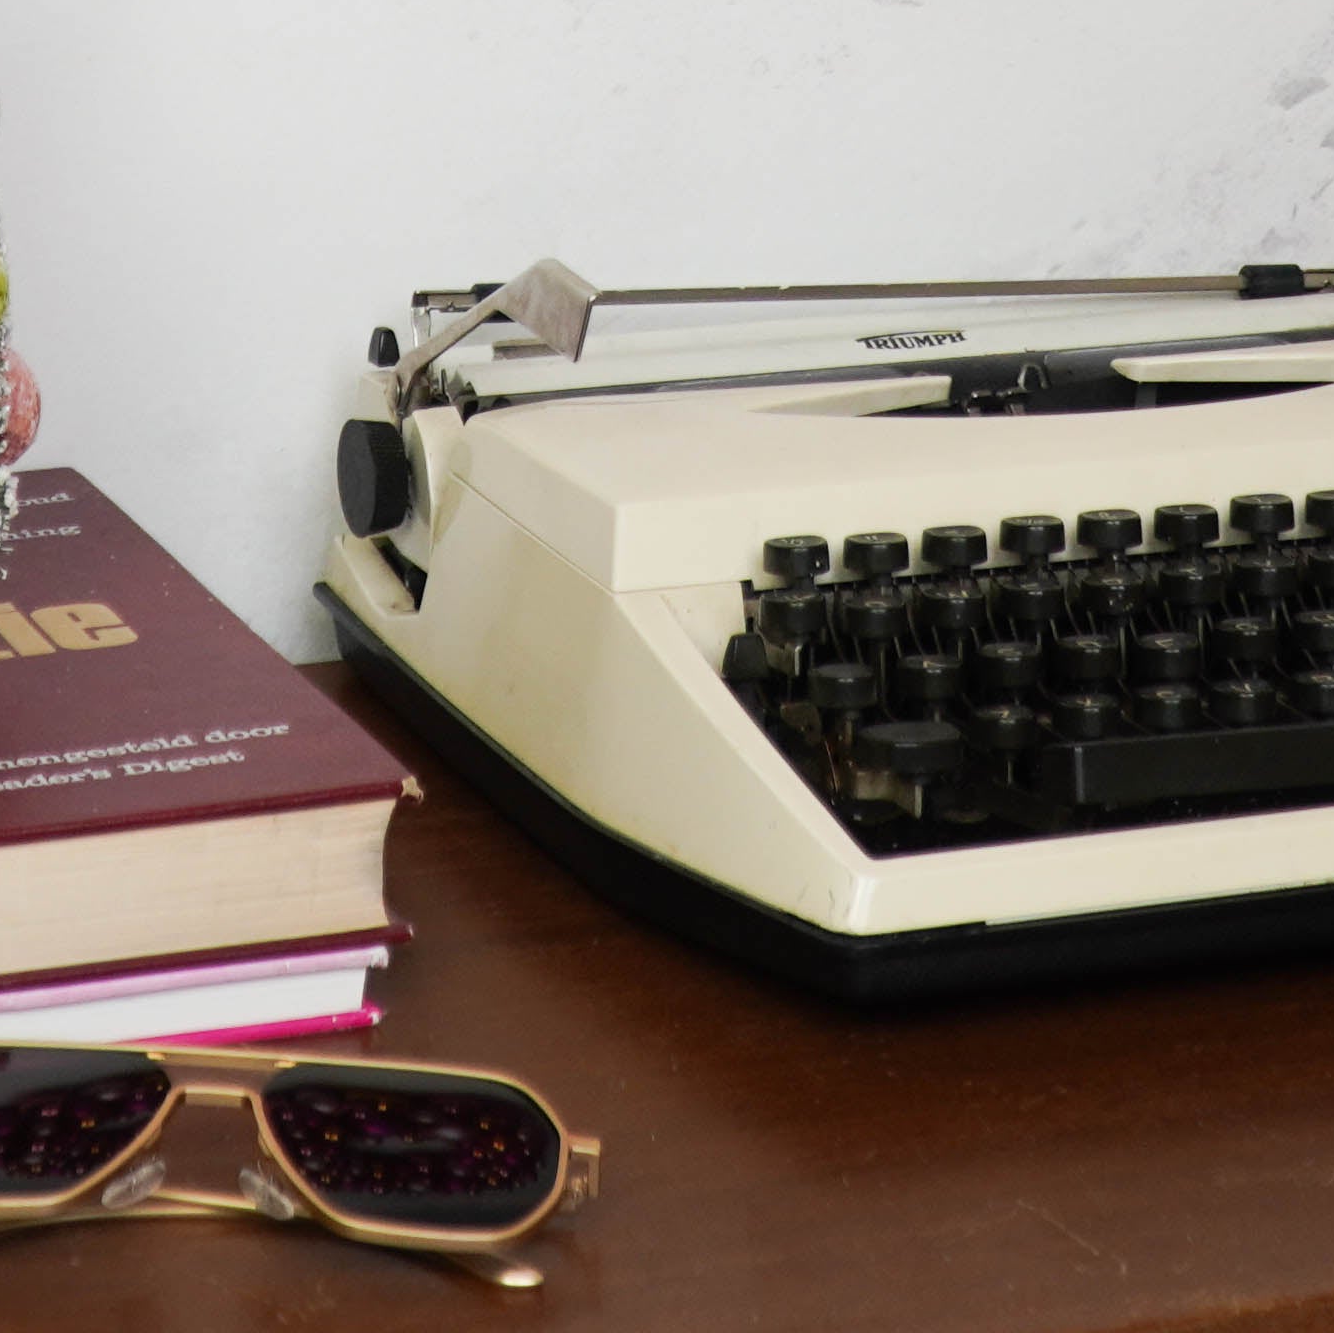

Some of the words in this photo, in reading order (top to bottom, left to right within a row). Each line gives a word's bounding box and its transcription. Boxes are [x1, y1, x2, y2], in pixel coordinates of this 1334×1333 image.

[856, 330, 967, 350] TRIUMPH
[204, 724, 290, 744] door
[118, 749, 246, 776] Digest
